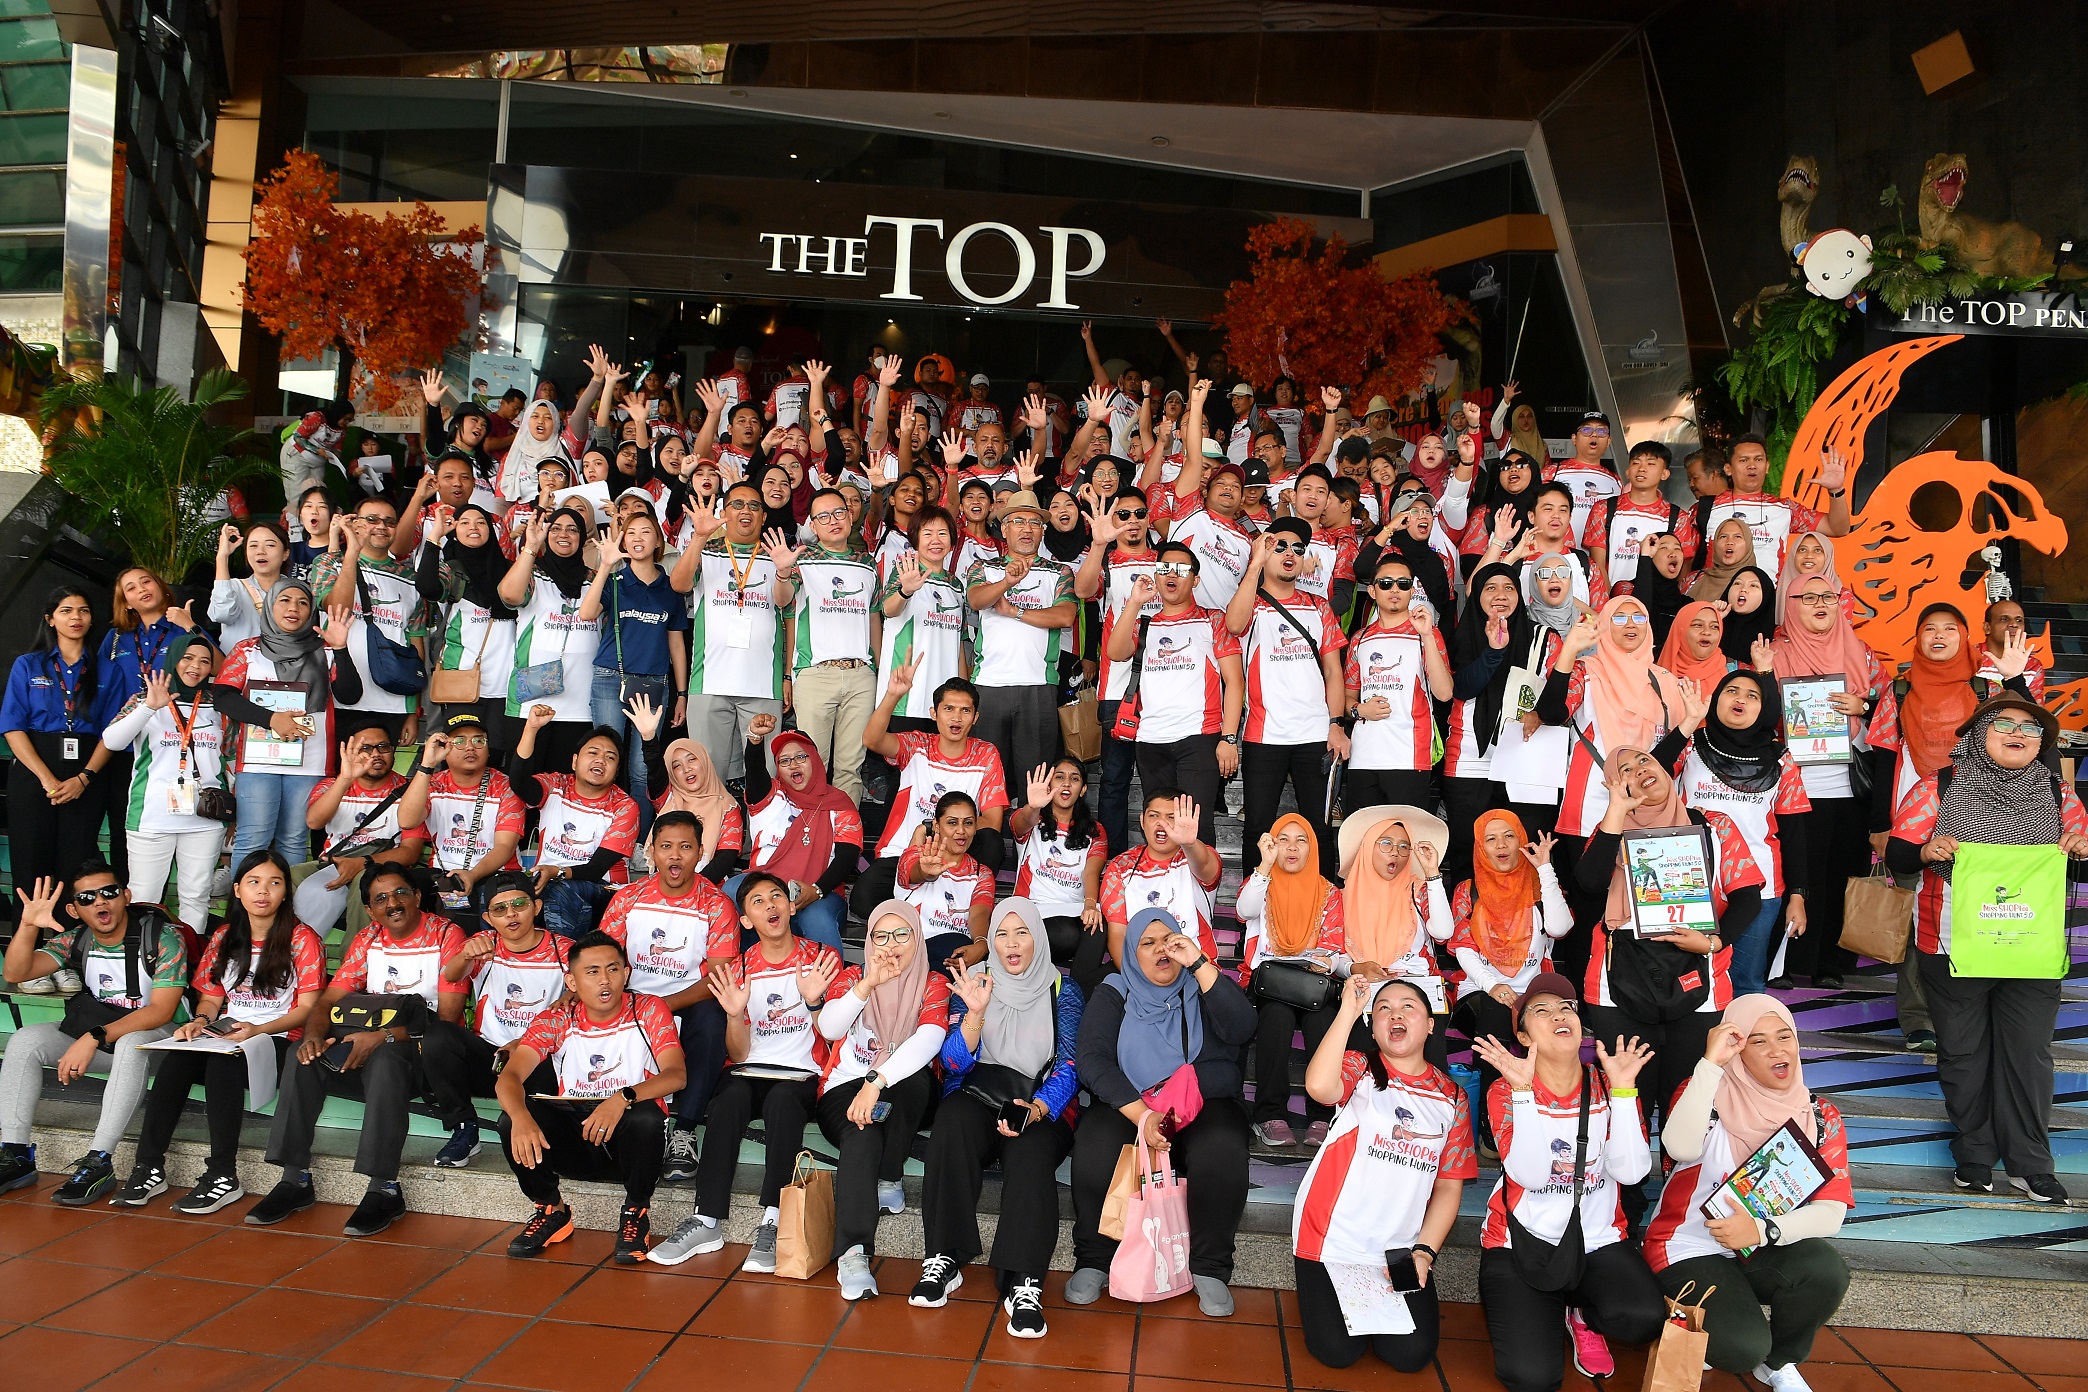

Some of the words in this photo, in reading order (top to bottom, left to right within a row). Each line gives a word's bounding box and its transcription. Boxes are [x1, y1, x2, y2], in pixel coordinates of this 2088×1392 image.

[759, 232, 868, 276] THE
[864, 214, 1106, 310] TOP
[1960, 300, 2027, 326] TOP
[2034, 308, 2088, 329] PEN
[716, 590, 733, 599] Miss
[734, 591, 768, 601] SOPhia
[712, 599, 740, 608] SHOPPIN
[745, 600, 761, 608] HUNT
[823, 598, 837, 607] Miss
[820, 606, 847, 614] SHOPPING
[550, 612, 566, 622] Miss
[1148, 656, 1163, 666] Miss
[1164, 656, 1192, 666] SHOPhia
[1270, 654, 1294, 662] SHOPPING
[1186, 663, 1196, 671] 5.0
[1373, 675, 1401, 684] SHOPhia
[193, 732, 216, 743] OPhia
[268, 743, 280, 758] 16
[1812, 738, 1828, 753] 44
[1698, 781, 1717, 792] Miss
[1694, 791, 1730, 801] SHOPPING
[1732, 793, 1752, 803] HUNT
[1752, 796, 1764, 805] 5.0
[772, 834, 782, 845] Mi
[1049, 868, 1080, 882] SHOPhia
[1983, 904, 1998, 912] Miss
[934, 910, 951, 922] Miss
[1667, 905, 1685, 923] 27
[636, 953, 652, 963] Mis
[652, 955, 686, 970] SHOPhia
[633, 963, 660, 975] SHOPING
[661, 967, 678, 978] HUNT
[677, 970, 689, 979] 5.0
[510, 1010, 537, 1021] SHOP
[520, 1020, 530, 1029] HU
[781, 1026, 798, 1034] HUNT
[798, 1022, 809, 1032] 5.0
[855, 1044, 873, 1060] Miss
[575, 1079, 593, 1091] Miss
[594, 1078, 627, 1091] SHOPhia
[568, 1088, 604, 1098] SHOPPING
[1374, 1133, 1397, 1150] Miss
[1368, 1145, 1408, 1166] SHOPPING
[1409, 1158, 1432, 1173] HUNT
